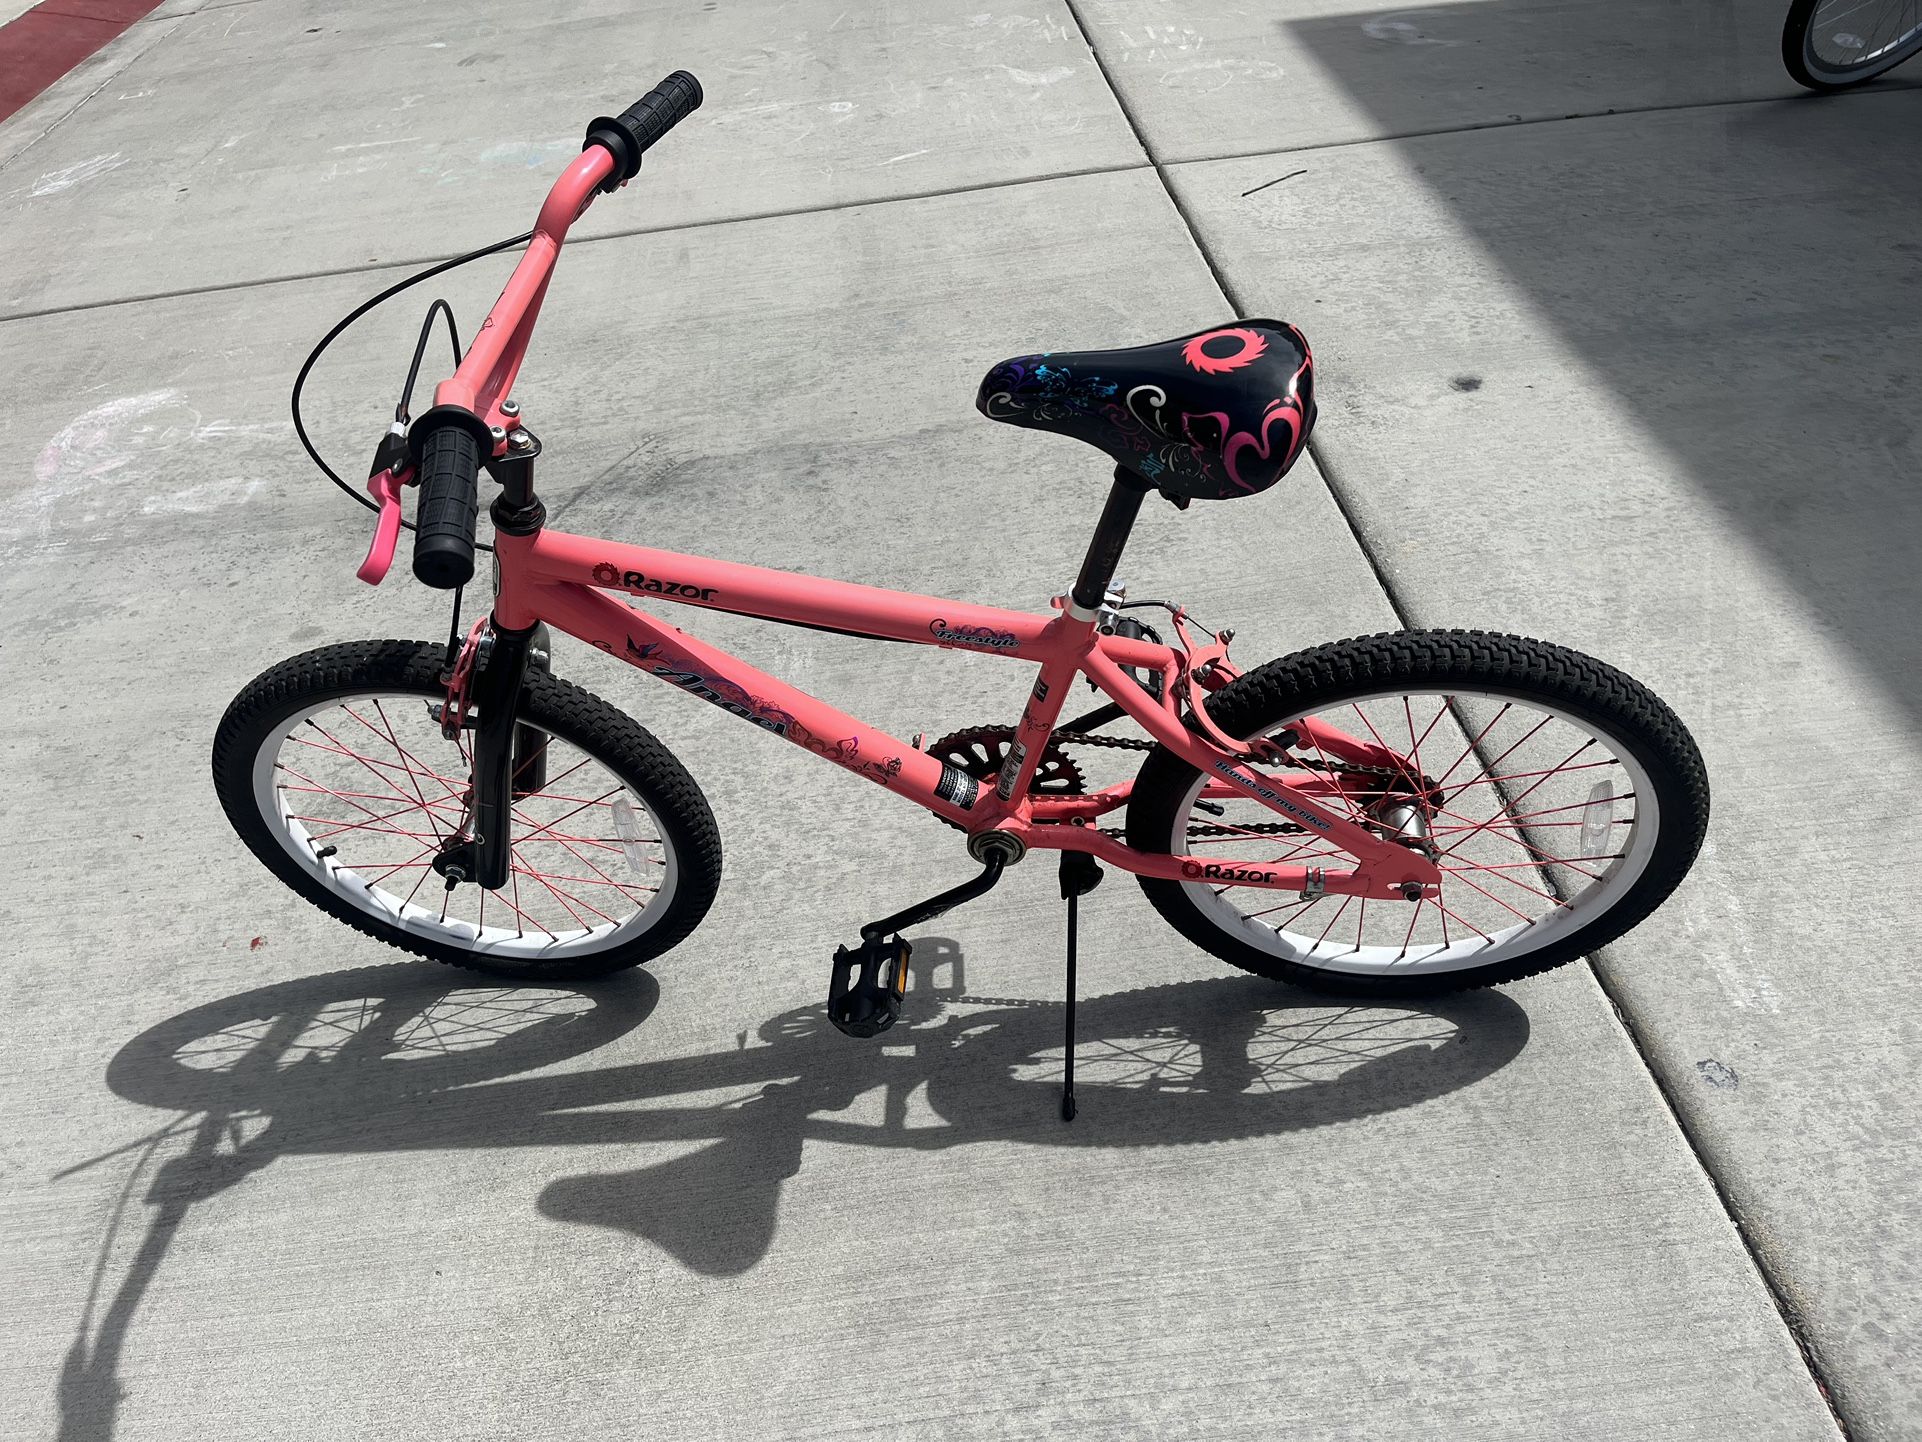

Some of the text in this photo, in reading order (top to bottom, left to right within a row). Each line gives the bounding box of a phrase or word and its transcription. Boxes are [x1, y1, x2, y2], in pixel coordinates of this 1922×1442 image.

[623, 570, 719, 601] Razor
[935, 628, 1020, 648] Freestyle
[1215, 760, 1257, 788] Hands
[1257, 787, 1277, 799] off
[1276, 798, 1297, 813] my
[1204, 863, 1278, 884] Razor
